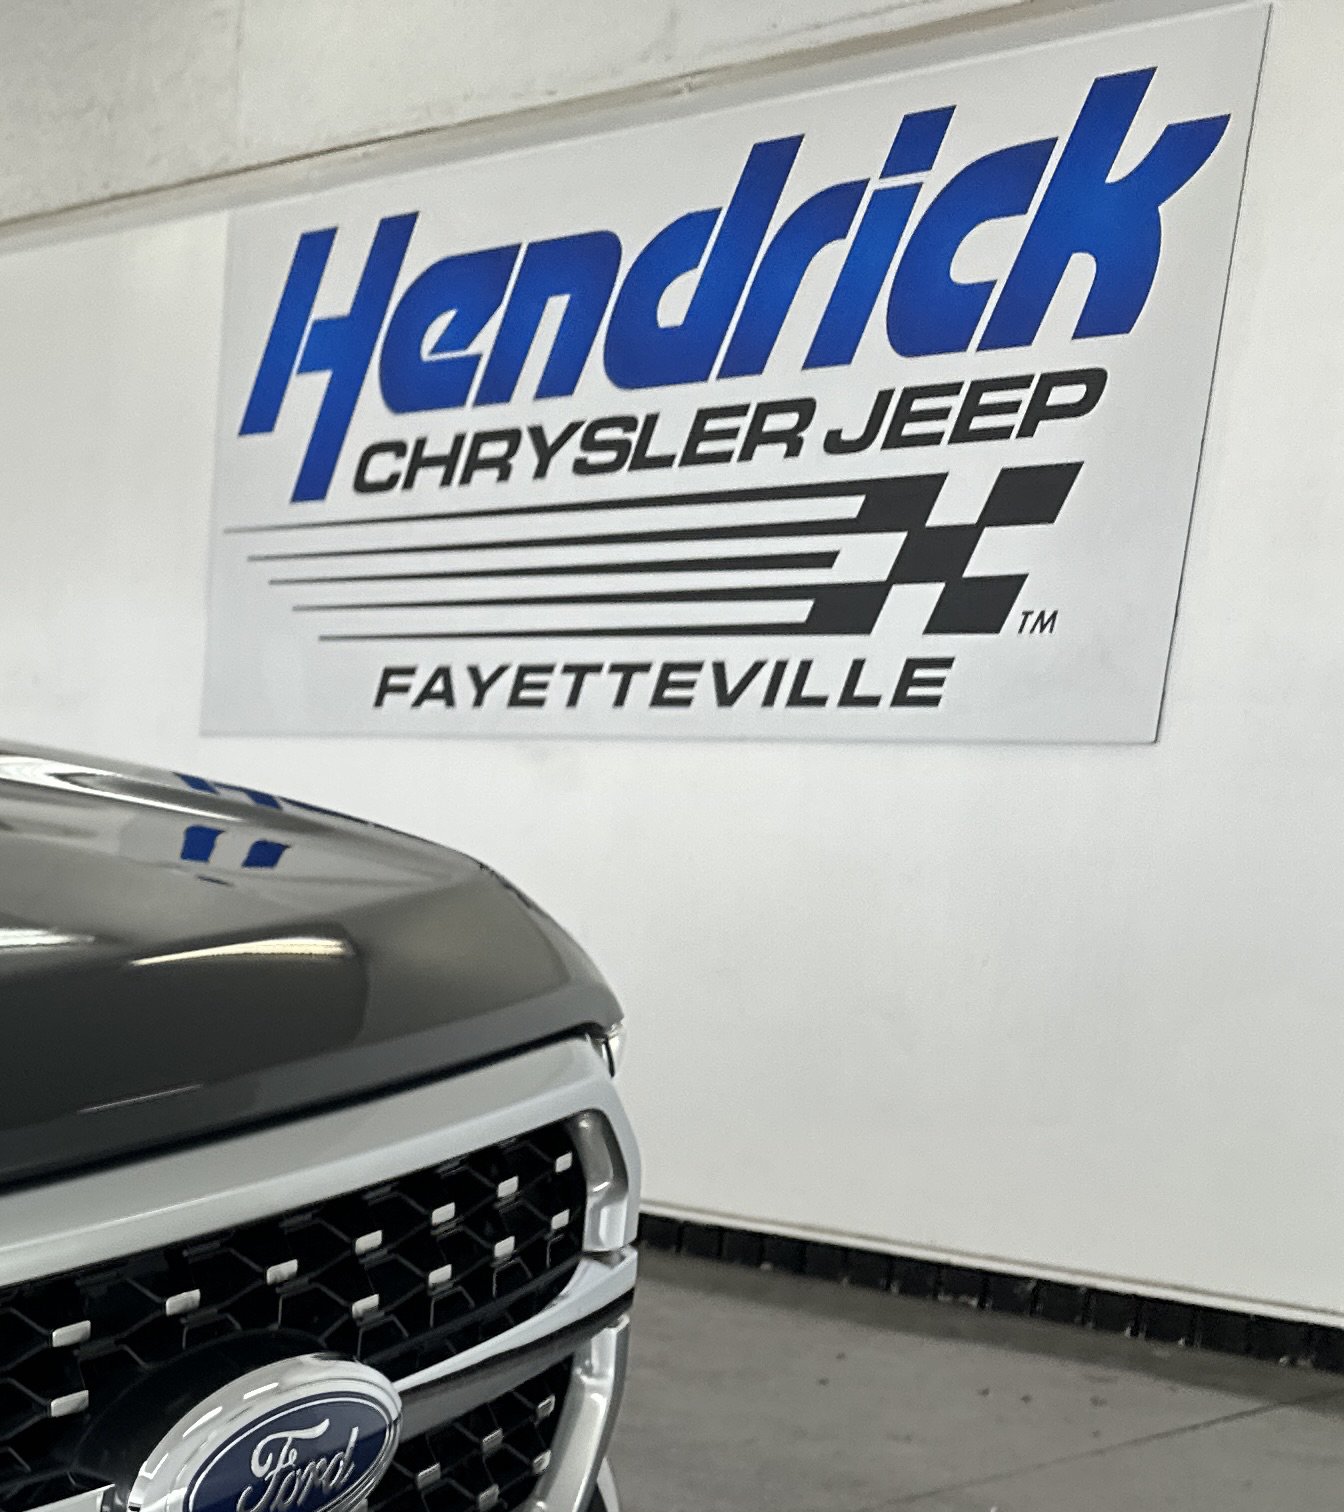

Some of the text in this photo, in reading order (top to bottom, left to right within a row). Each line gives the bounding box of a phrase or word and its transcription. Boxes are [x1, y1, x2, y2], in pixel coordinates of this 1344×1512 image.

[238, 66, 1231, 504] Hendrick
[353, 367, 1108, 494] CHRYSLER JEEP
[1018, 609, 1058, 634] TM
[373, 656, 955, 709] FAYETTEVILLE
